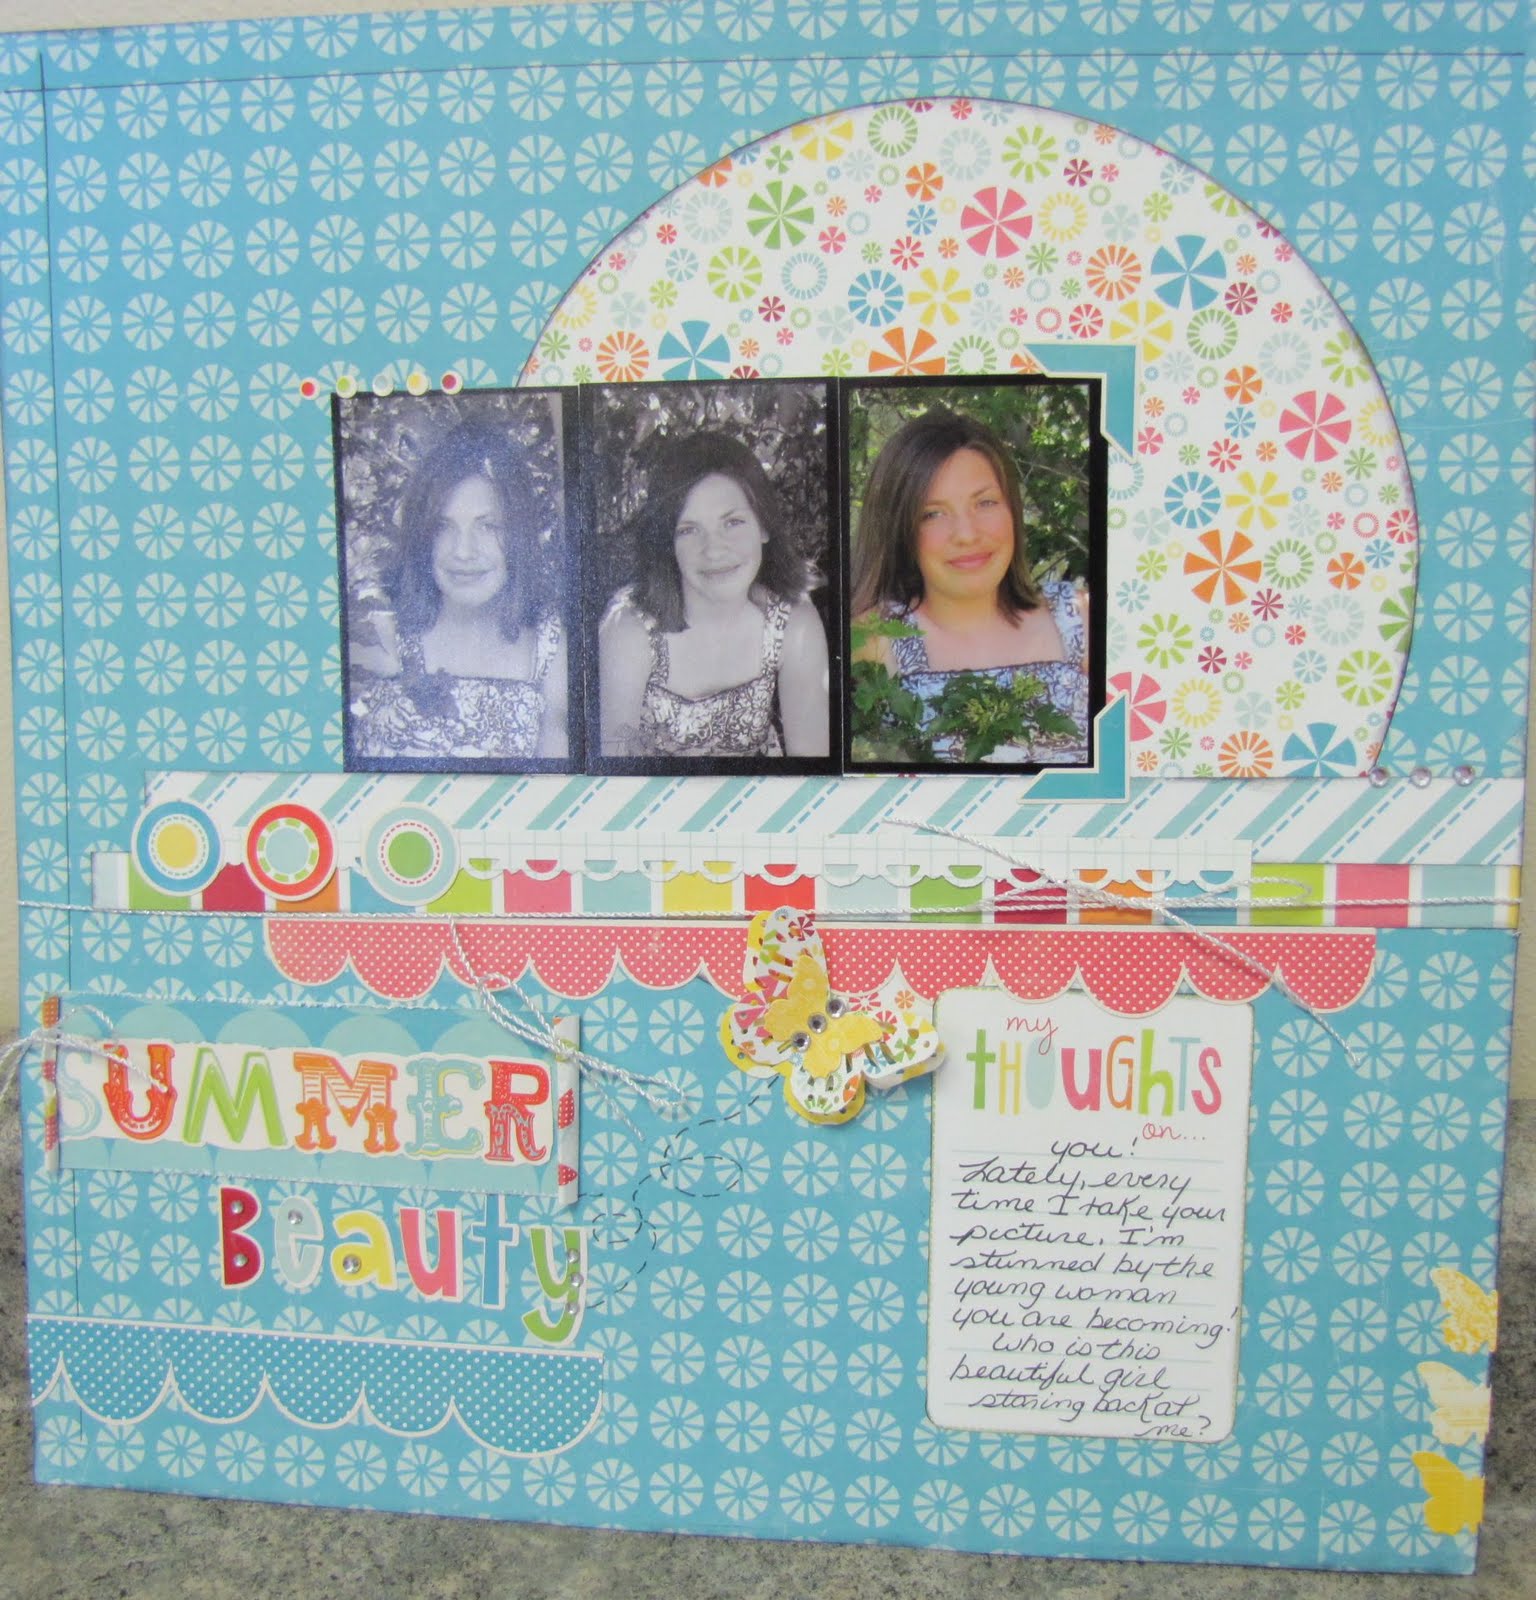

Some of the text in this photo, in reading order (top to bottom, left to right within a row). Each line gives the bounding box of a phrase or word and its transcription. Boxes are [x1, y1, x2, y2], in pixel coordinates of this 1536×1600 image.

[1007, 1014, 1058, 1055] my
[59, 1043, 550, 1162] SUMMER
[1051, 1136, 1138, 1163] you!
[959, 1156, 1191, 1204] Lately, every
[951, 1189, 1226, 1229] time I take your
[1119, 1226, 1184, 1246] I'm
[220, 1188, 586, 1342] Beauty
[950, 1249, 1104, 1273] stunned
[954, 1277, 1177, 1309] young woman
[952, 1307, 1238, 1349] you are becoming!
[1065, 1336, 1092, 1355] is
[1096, 1338, 1160, 1360] this
[950, 1354, 1171, 1391] beautiful girl
[969, 1389, 1084, 1422] staring
[1134, 1415, 1212, 1438] me?
